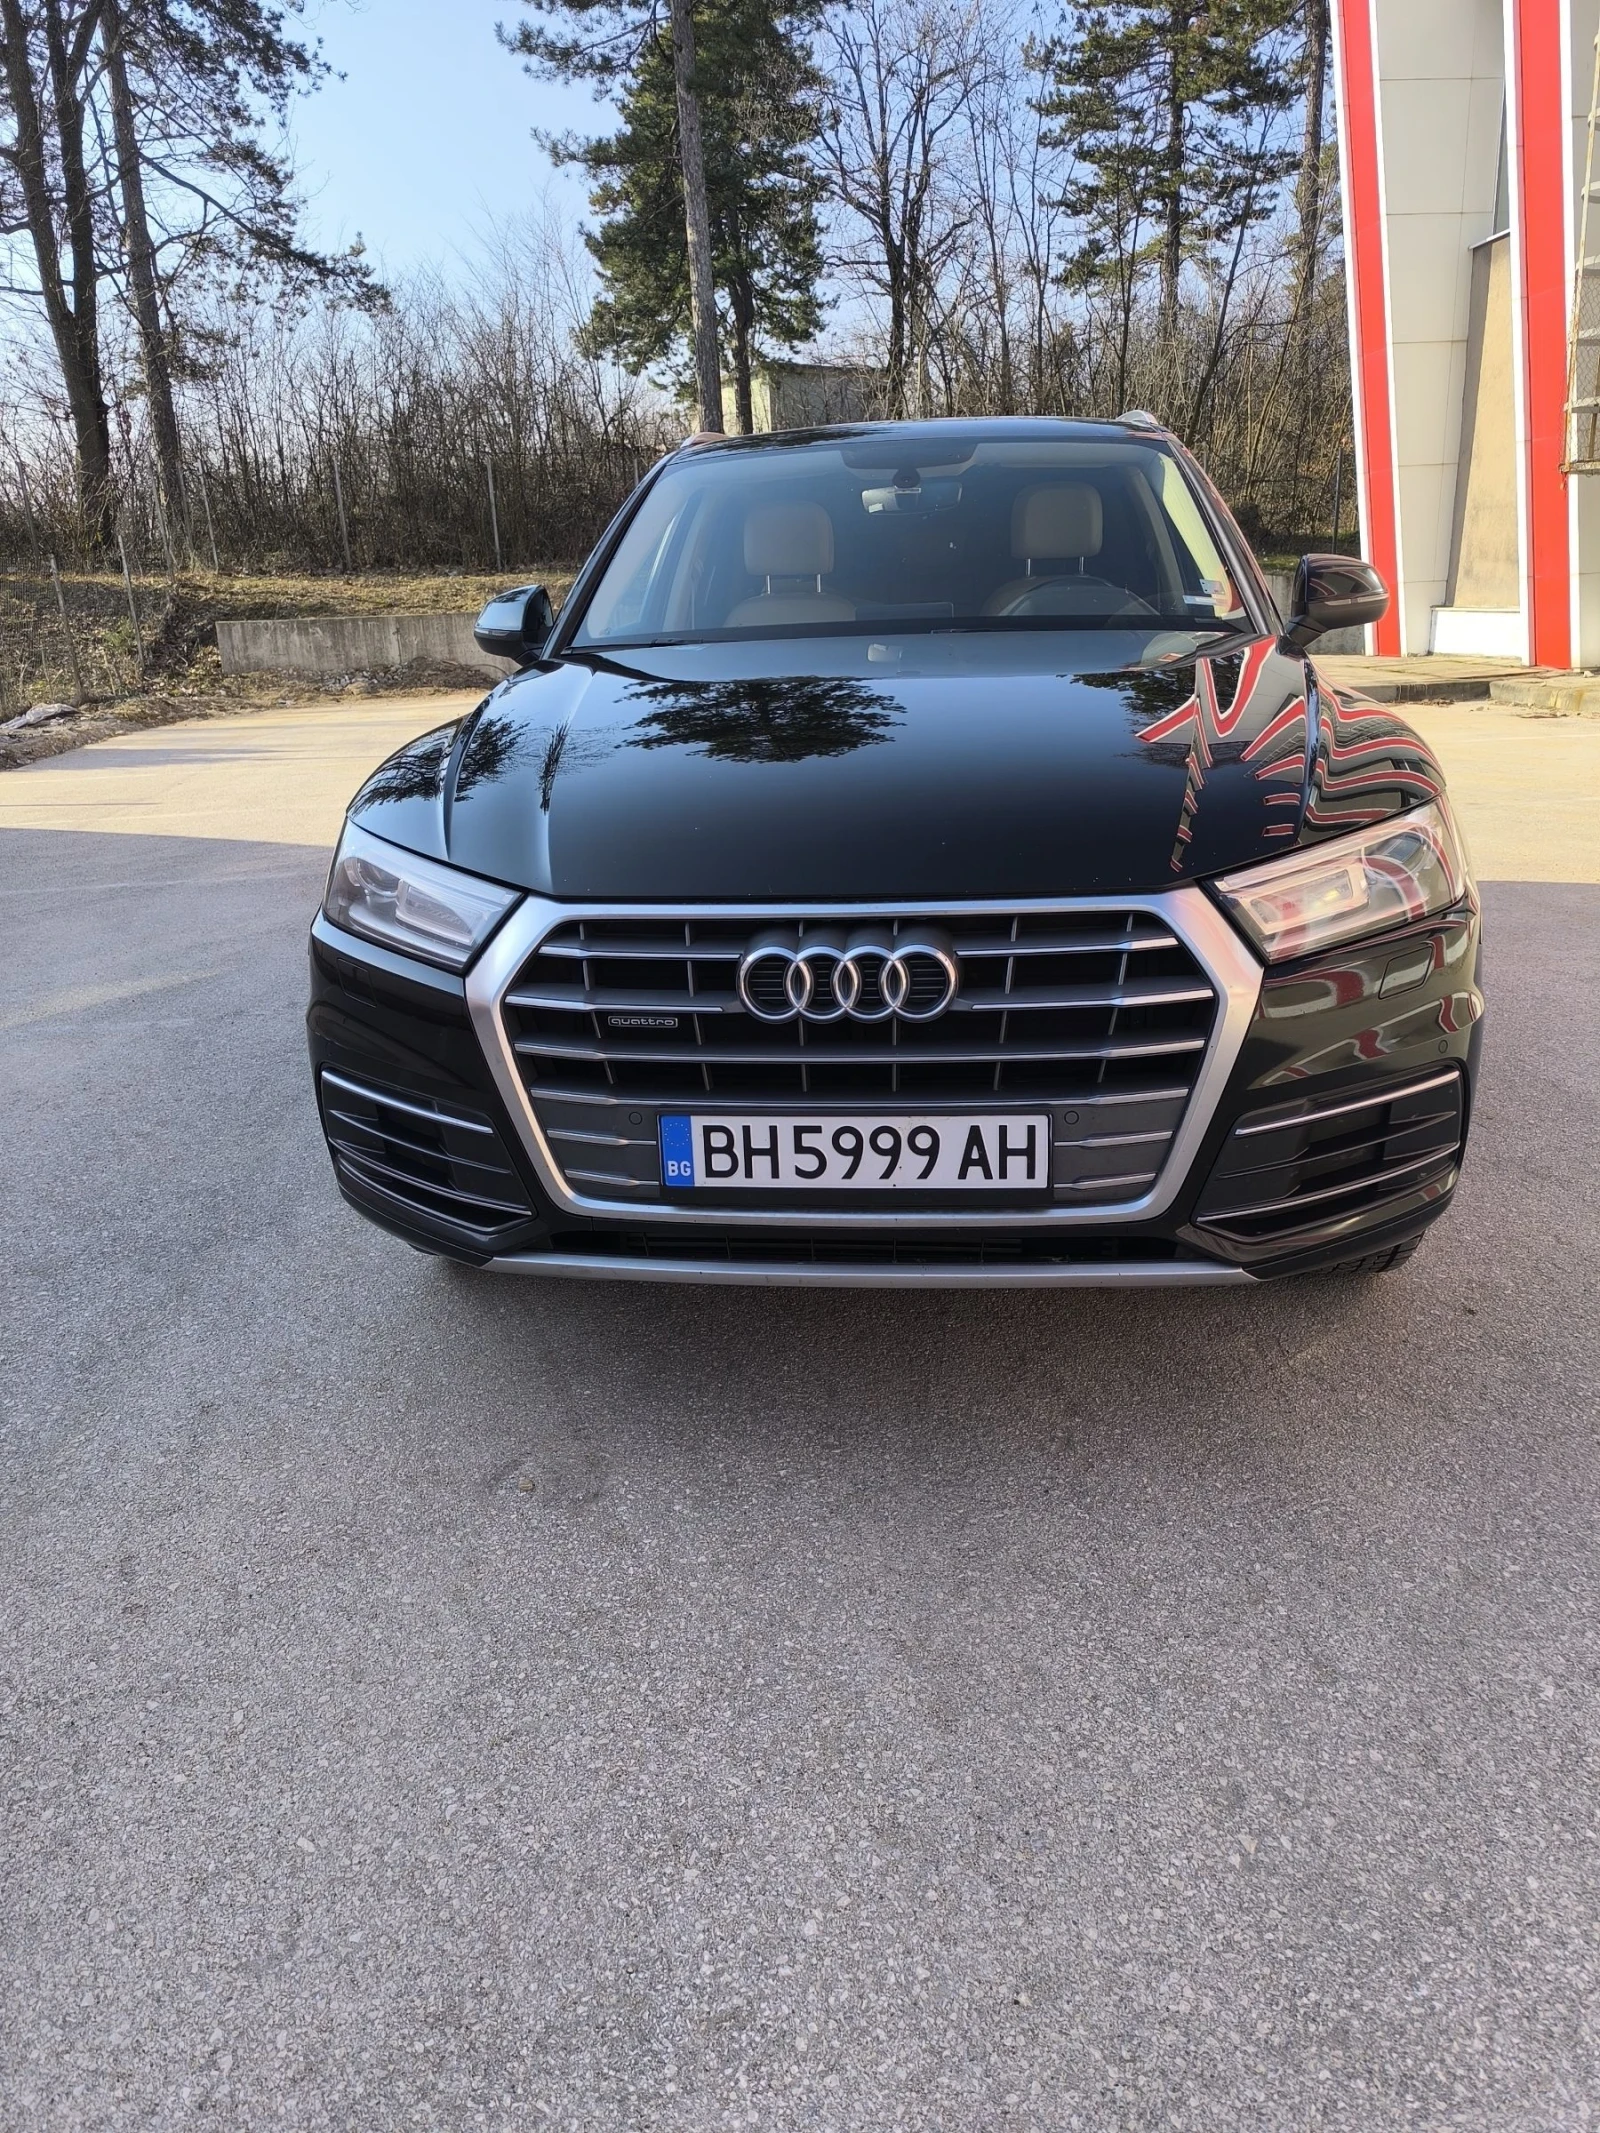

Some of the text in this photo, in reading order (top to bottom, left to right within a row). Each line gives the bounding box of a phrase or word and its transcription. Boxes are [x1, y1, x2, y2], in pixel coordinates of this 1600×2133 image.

[611, 1018, 674, 1026] quattro
[702, 1124, 1036, 1179] BH 5999 AH
[667, 1160, 691, 1176] BG
